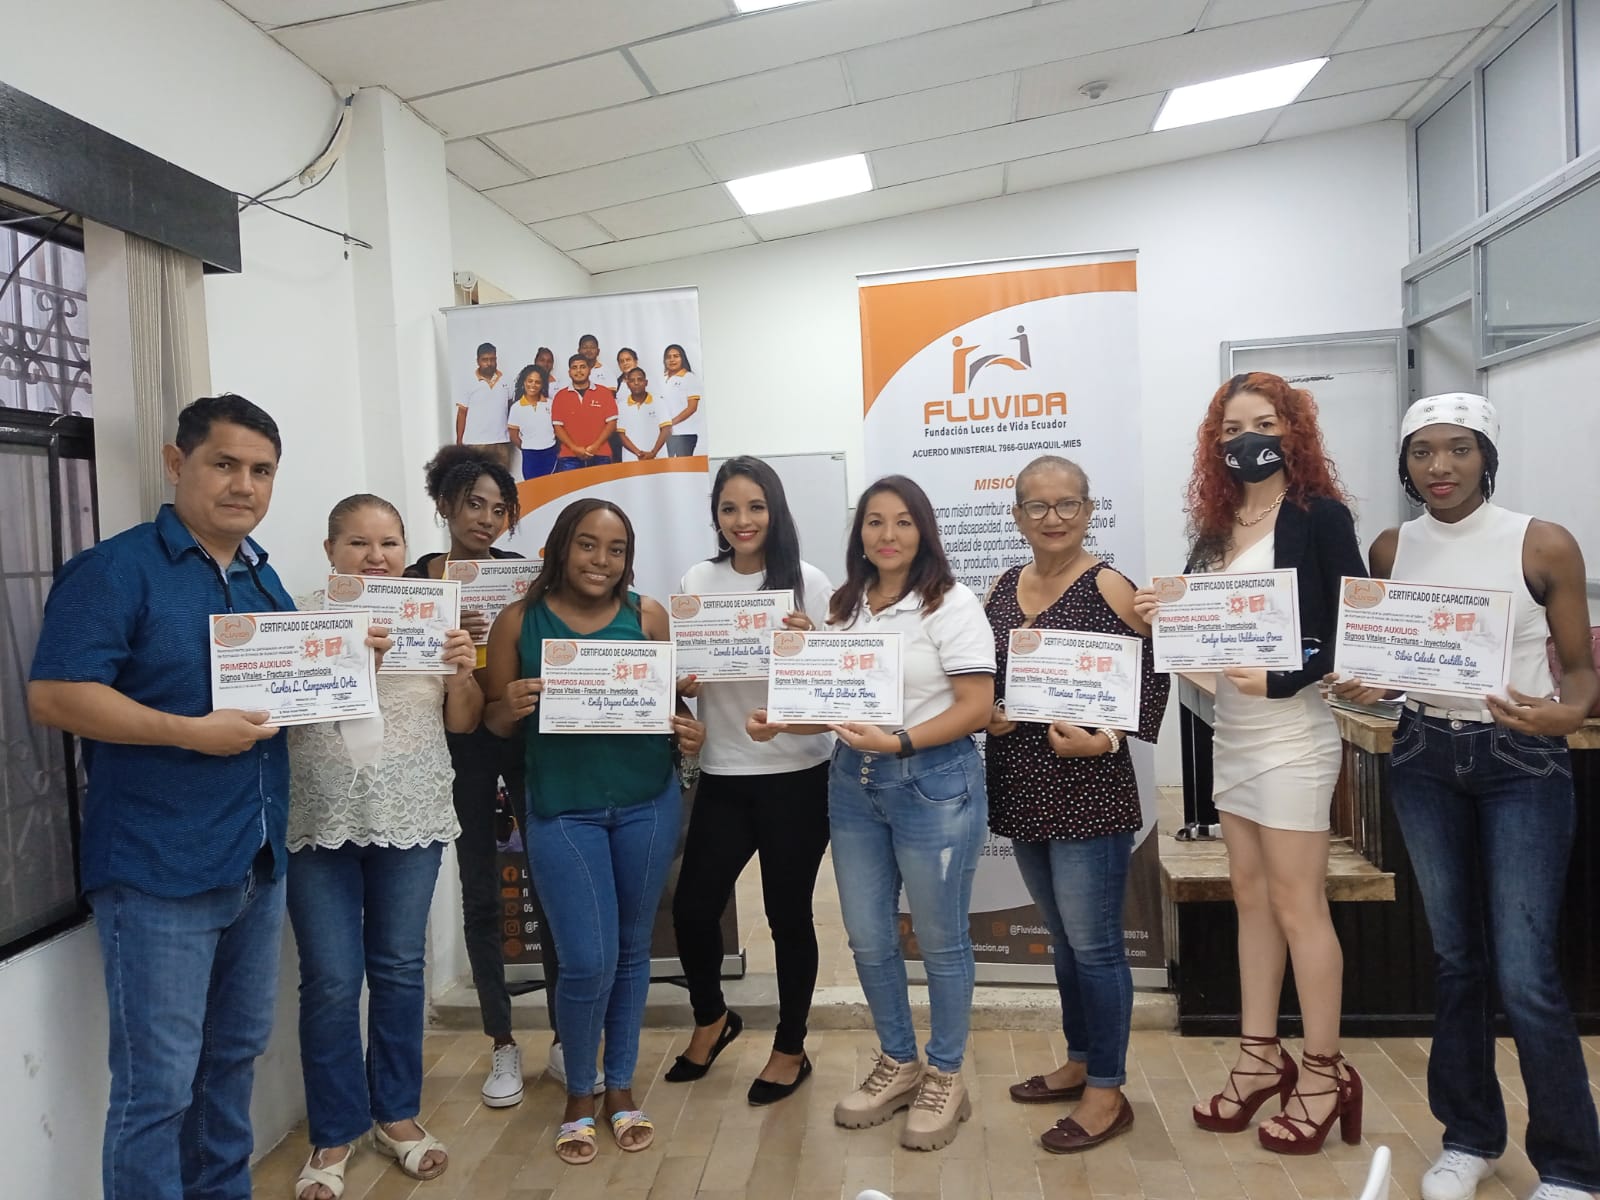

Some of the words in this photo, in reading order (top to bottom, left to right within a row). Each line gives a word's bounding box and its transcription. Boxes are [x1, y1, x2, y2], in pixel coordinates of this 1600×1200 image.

[924, 392, 1067, 424] FLUVIDA
[925, 425, 968, 437] Fundación
[971, 425, 994, 434] Luces
[996, 422, 1007, 432] de
[1010, 421, 1028, 431] Vida
[1032, 419, 1067, 430] Ecuador
[912, 446, 949, 458] ACUERDO
[950, 444, 997, 455] MINISTERIAL
[974, 475, 1017, 490] MISIÓ
[1102, 497, 1112, 510] los
[481, 566, 511, 575] CERTIFICADO
[368, 584, 400, 595] CERTIFICADO
[402, 586, 408, 594] DE
[1190, 581, 1225, 591] CERTIFICADO
[1226, 581, 1233, 590] DE
[1389, 590, 1430, 602] CERTIFICADO
[1432, 594, 1440, 603] DE
[704, 600, 733, 609] CERTIFICADO
[260, 620, 299, 632] CERTIFICADO
[301, 621, 309, 630] DE
[1346, 623, 1383, 633] PRIMEROS
[1384, 625, 1419, 636] AUXILIOS:
[1044, 637, 1077, 646] CERTIFICADO
[1344, 632, 1364, 641] Signos
[1366, 634, 1386, 643] Vitales
[1391, 636, 1419, 645] Fracturas
[580, 648, 614, 657] CERTIFICADO
[615, 648, 620, 656] DE
[220, 662, 258, 671] PRIMEROS
[260, 660, 293, 669] AUXILIOS:
[220, 673, 240, 682] Signos
[243, 672, 262, 680] Vitales
[267, 670, 293, 679] Fracturas
